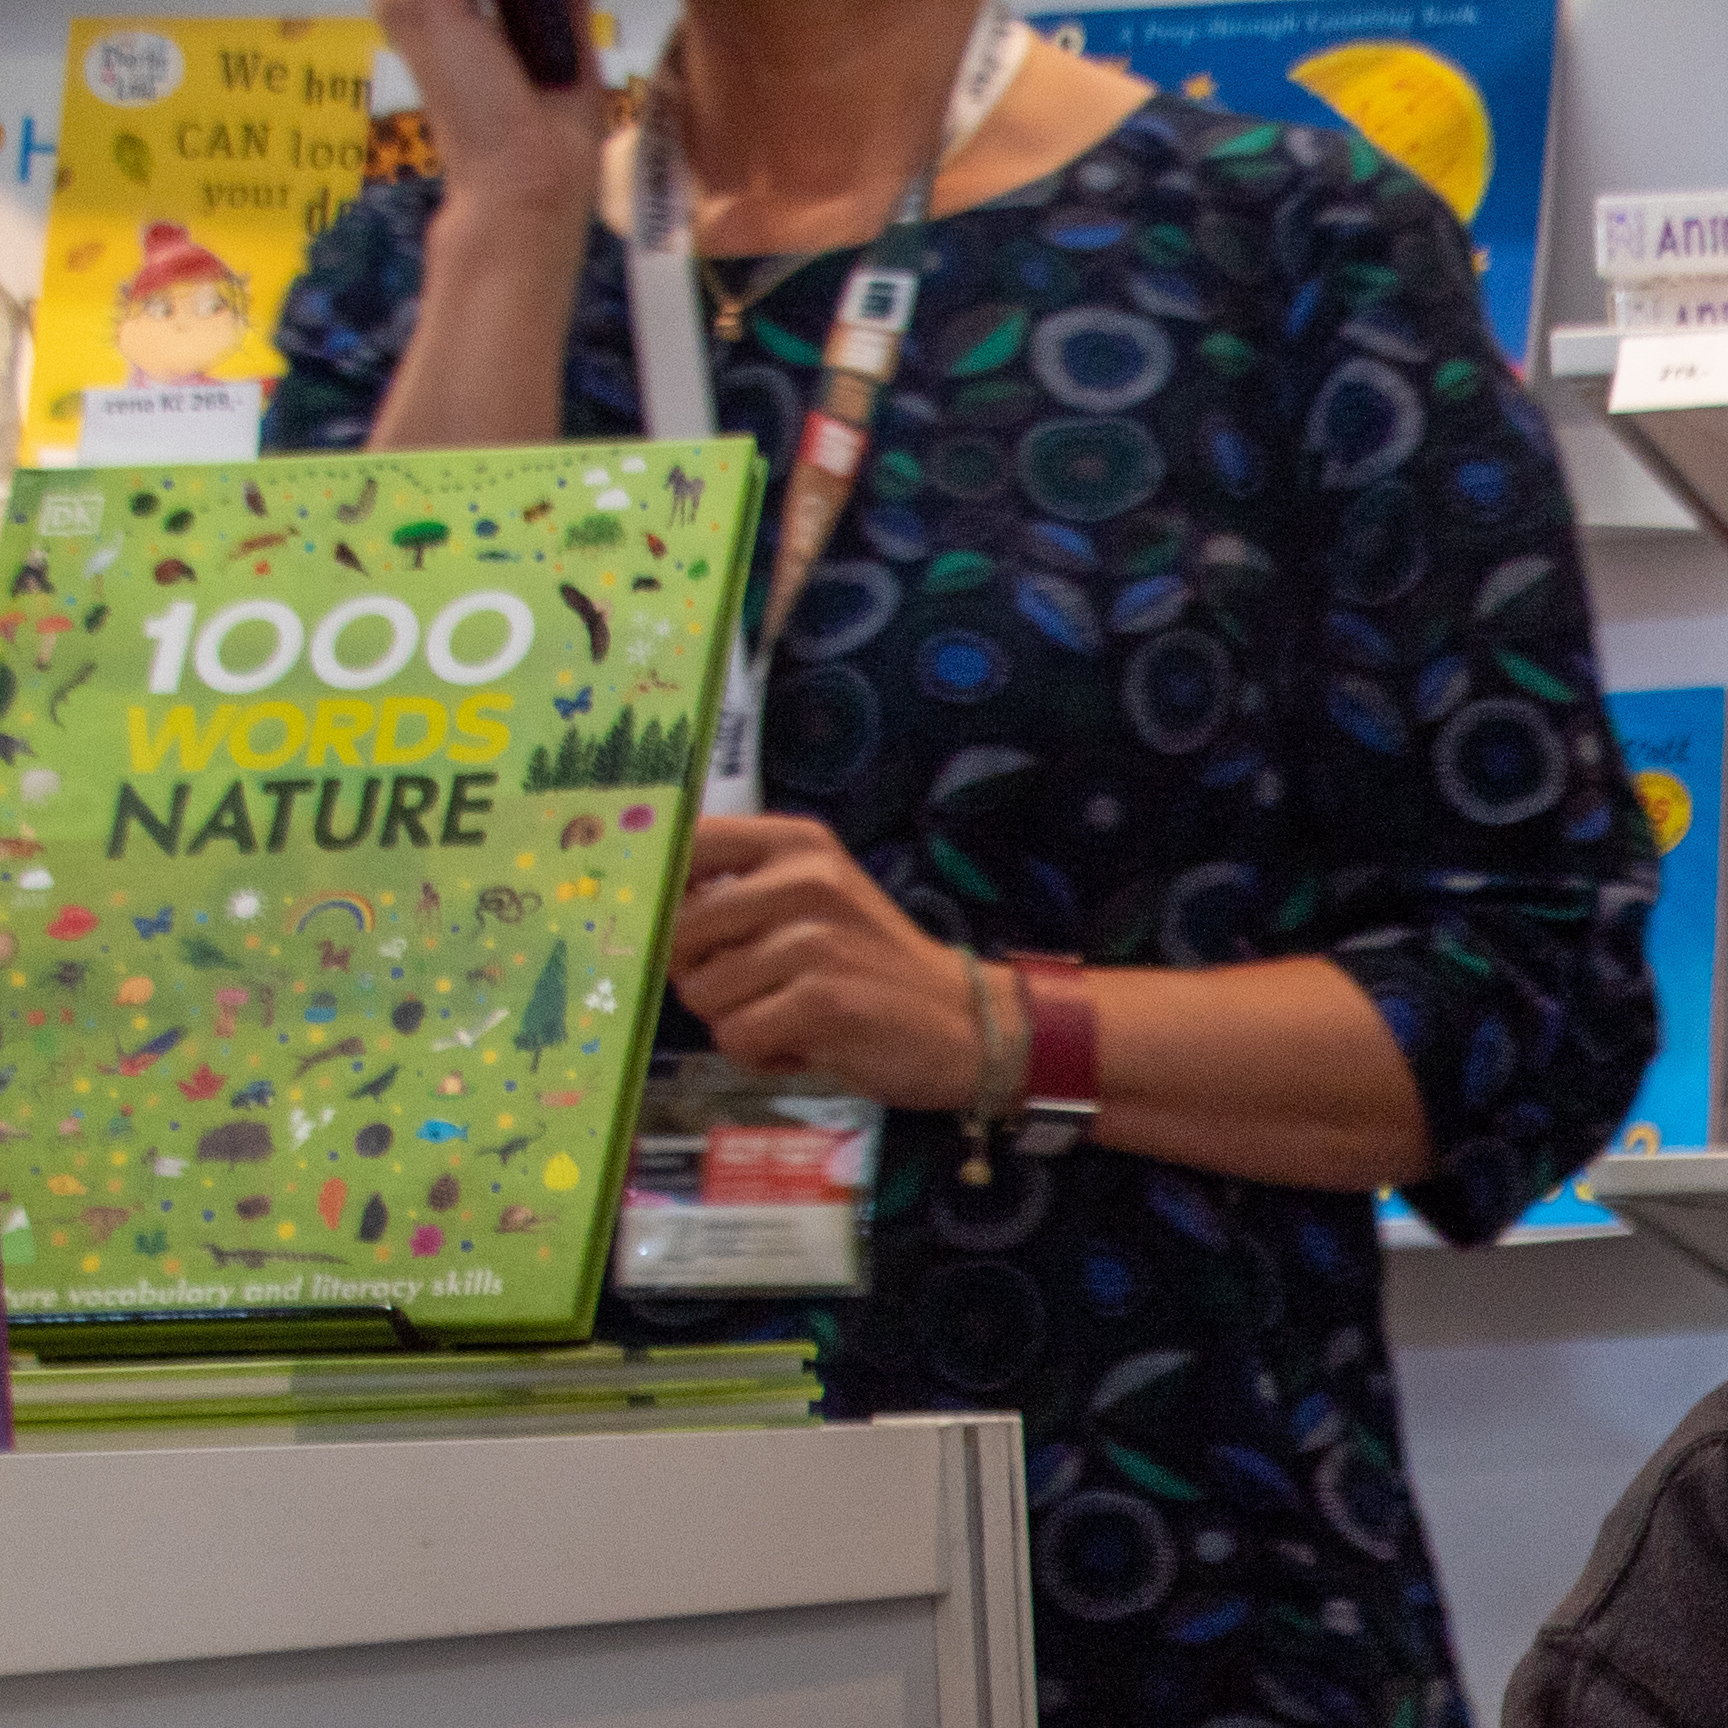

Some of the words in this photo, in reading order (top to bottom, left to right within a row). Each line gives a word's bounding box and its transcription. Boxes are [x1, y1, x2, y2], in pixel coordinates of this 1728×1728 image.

[218, 48, 290, 95] We
[175, 120, 270, 161] CAN
[143, 588, 536, 696] 1000
[126, 692, 516, 774] WORDS
[106, 771, 500, 860] NATURE
[68, 1277, 234, 1309] vocabulary
[242, 1275, 304, 1304] and
[311, 1272, 423, 1303] literacy
[431, 1268, 504, 1298] skills
